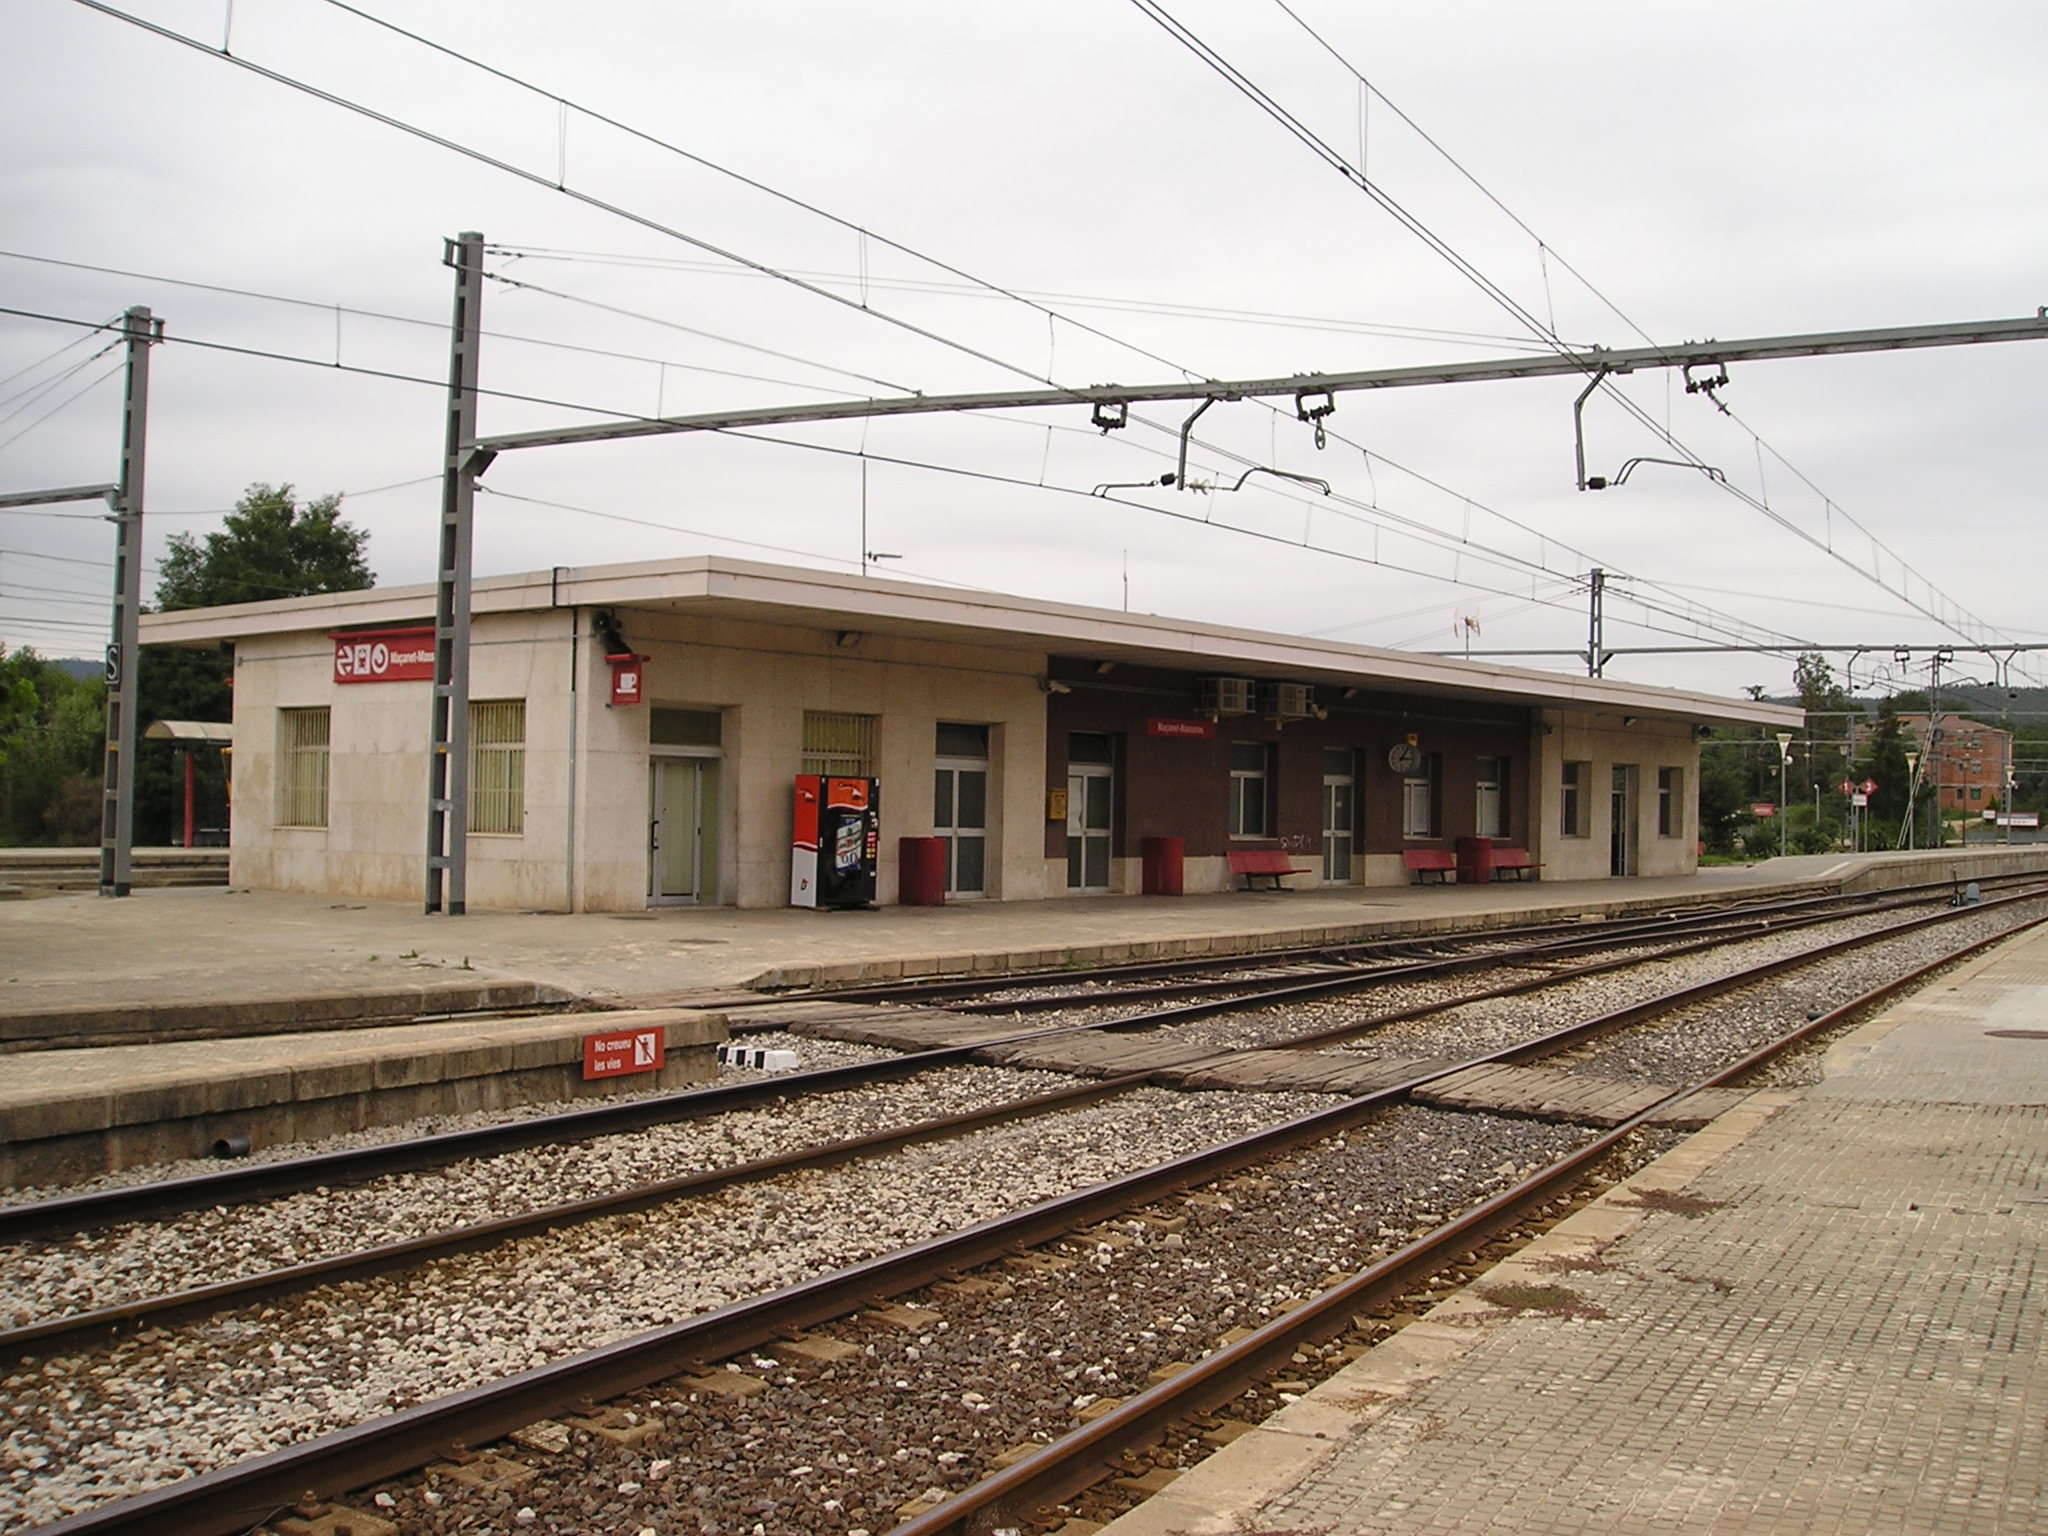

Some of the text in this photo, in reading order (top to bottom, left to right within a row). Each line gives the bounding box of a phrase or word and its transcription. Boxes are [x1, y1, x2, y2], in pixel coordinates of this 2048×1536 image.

[390, 651, 435, 666] Maçanet-Mass
[594, 1040, 606, 1053] No
[594, 1058, 621, 1072] les vies
